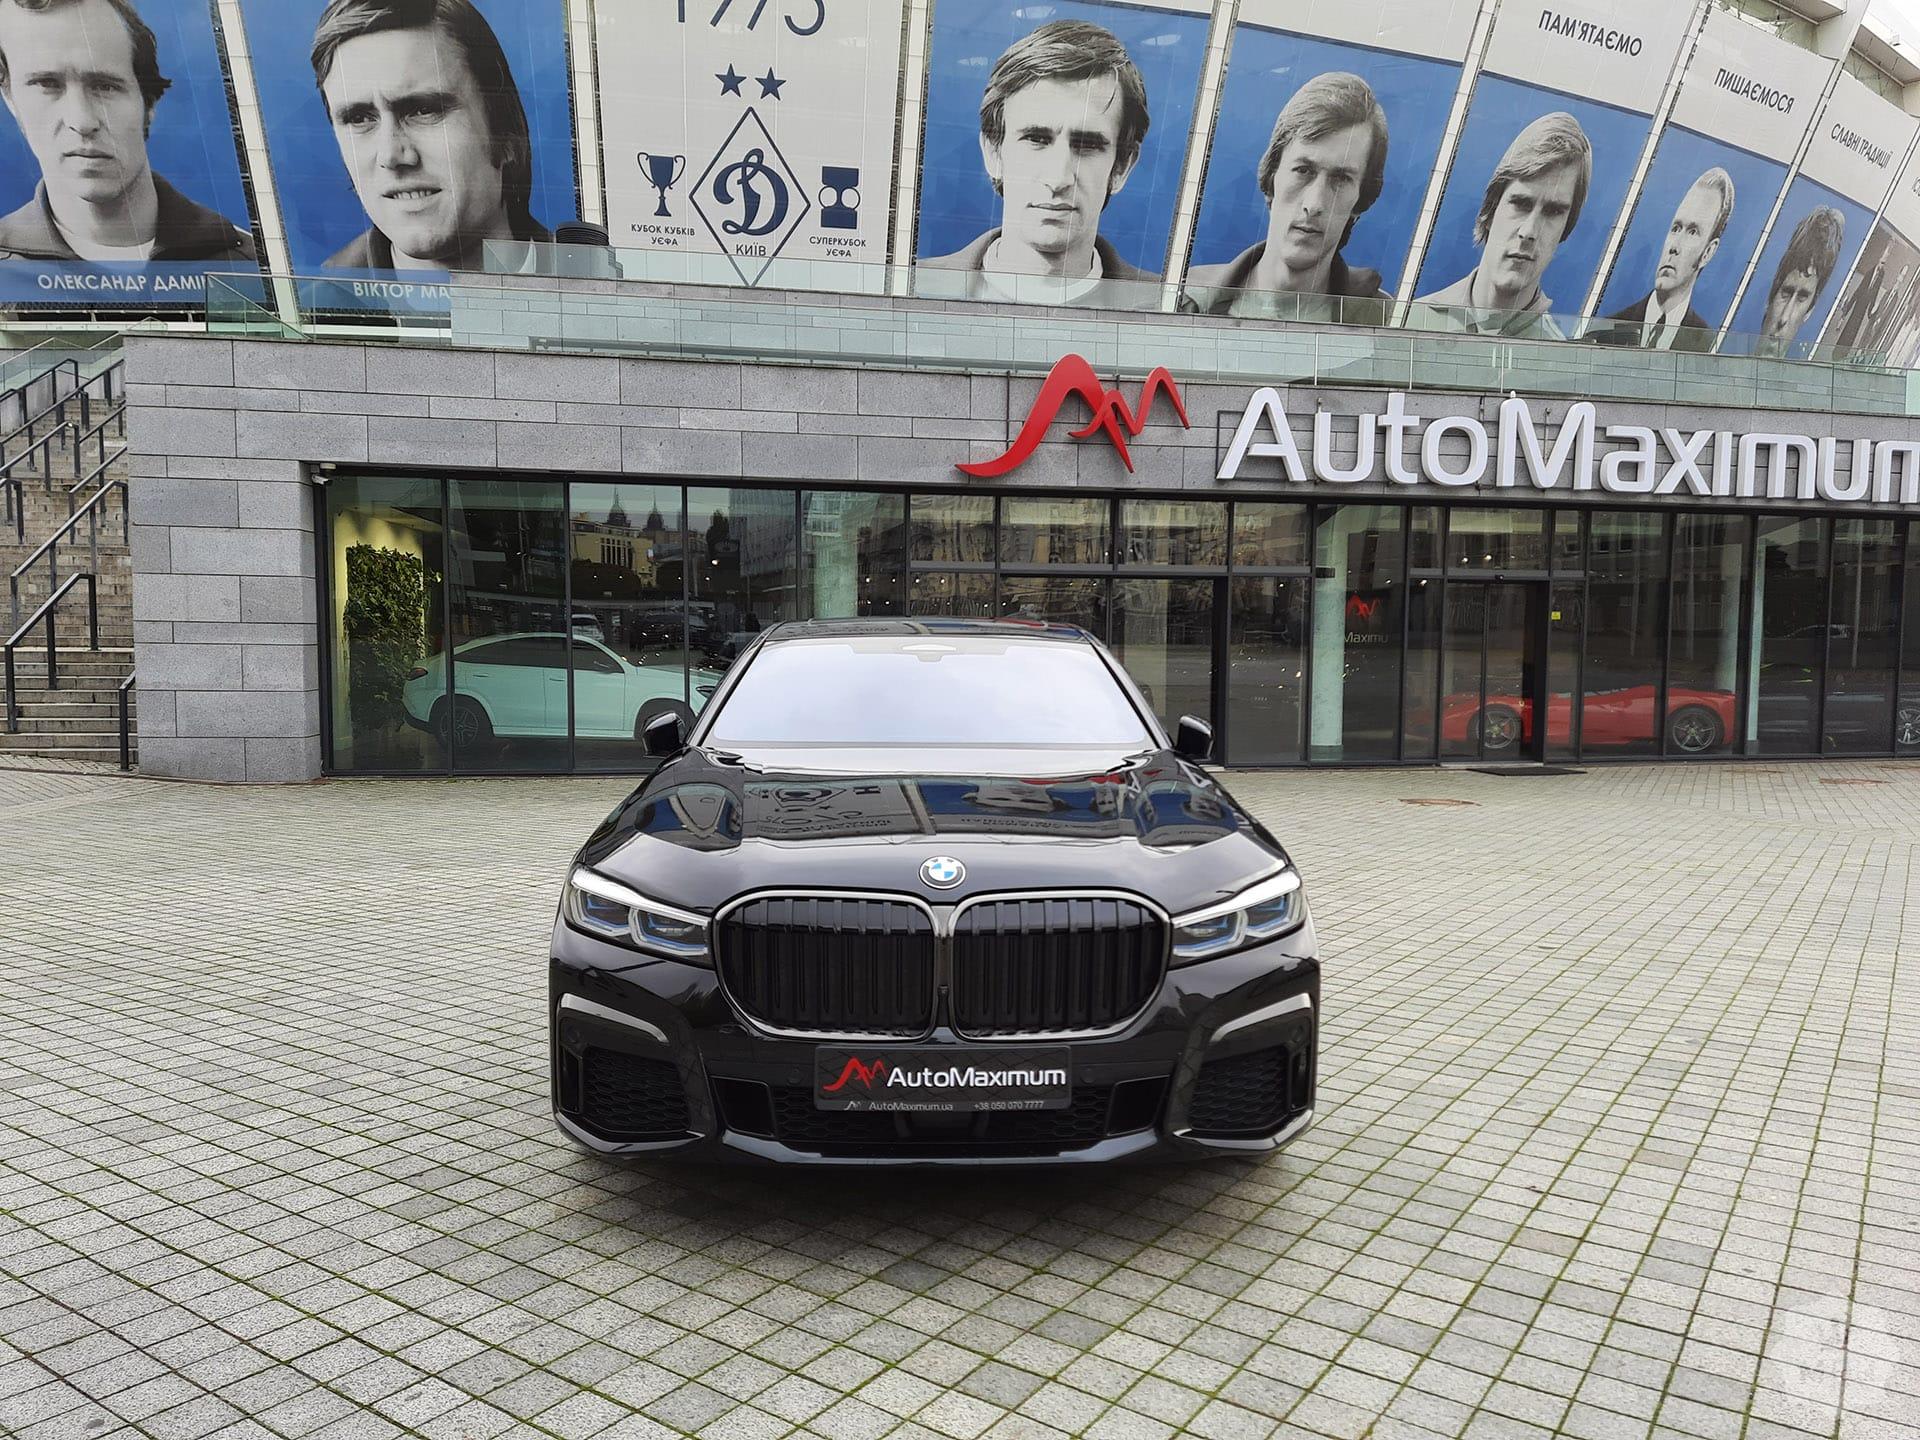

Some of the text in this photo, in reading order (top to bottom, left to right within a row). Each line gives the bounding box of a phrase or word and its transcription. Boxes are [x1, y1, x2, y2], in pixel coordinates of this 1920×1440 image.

[1538, 10, 1643, 57] ПАМ'ЯТАЄМО
[1713, 68, 1795, 115] ПИШАЄМОСЯ
[1831, 123, 1861, 152] СЛАВНІ
[631, 223, 696, 236] КУБОК КУБКІВ
[651, 236, 679, 246] УЄФА
[735, 241, 767, 257] КИЇВ
[809, 235, 867, 248] СУПЕРКУБОК
[826, 248, 852, 258] УЄФА
[37, 273, 147, 292] ОЛЕКСАНДР
[353, 281, 414, 299] ВІКТОР
[887, 1067, 1067, 1088] AutoMaximum
[868, 1101, 954, 1112] AutoMaximum.ua
